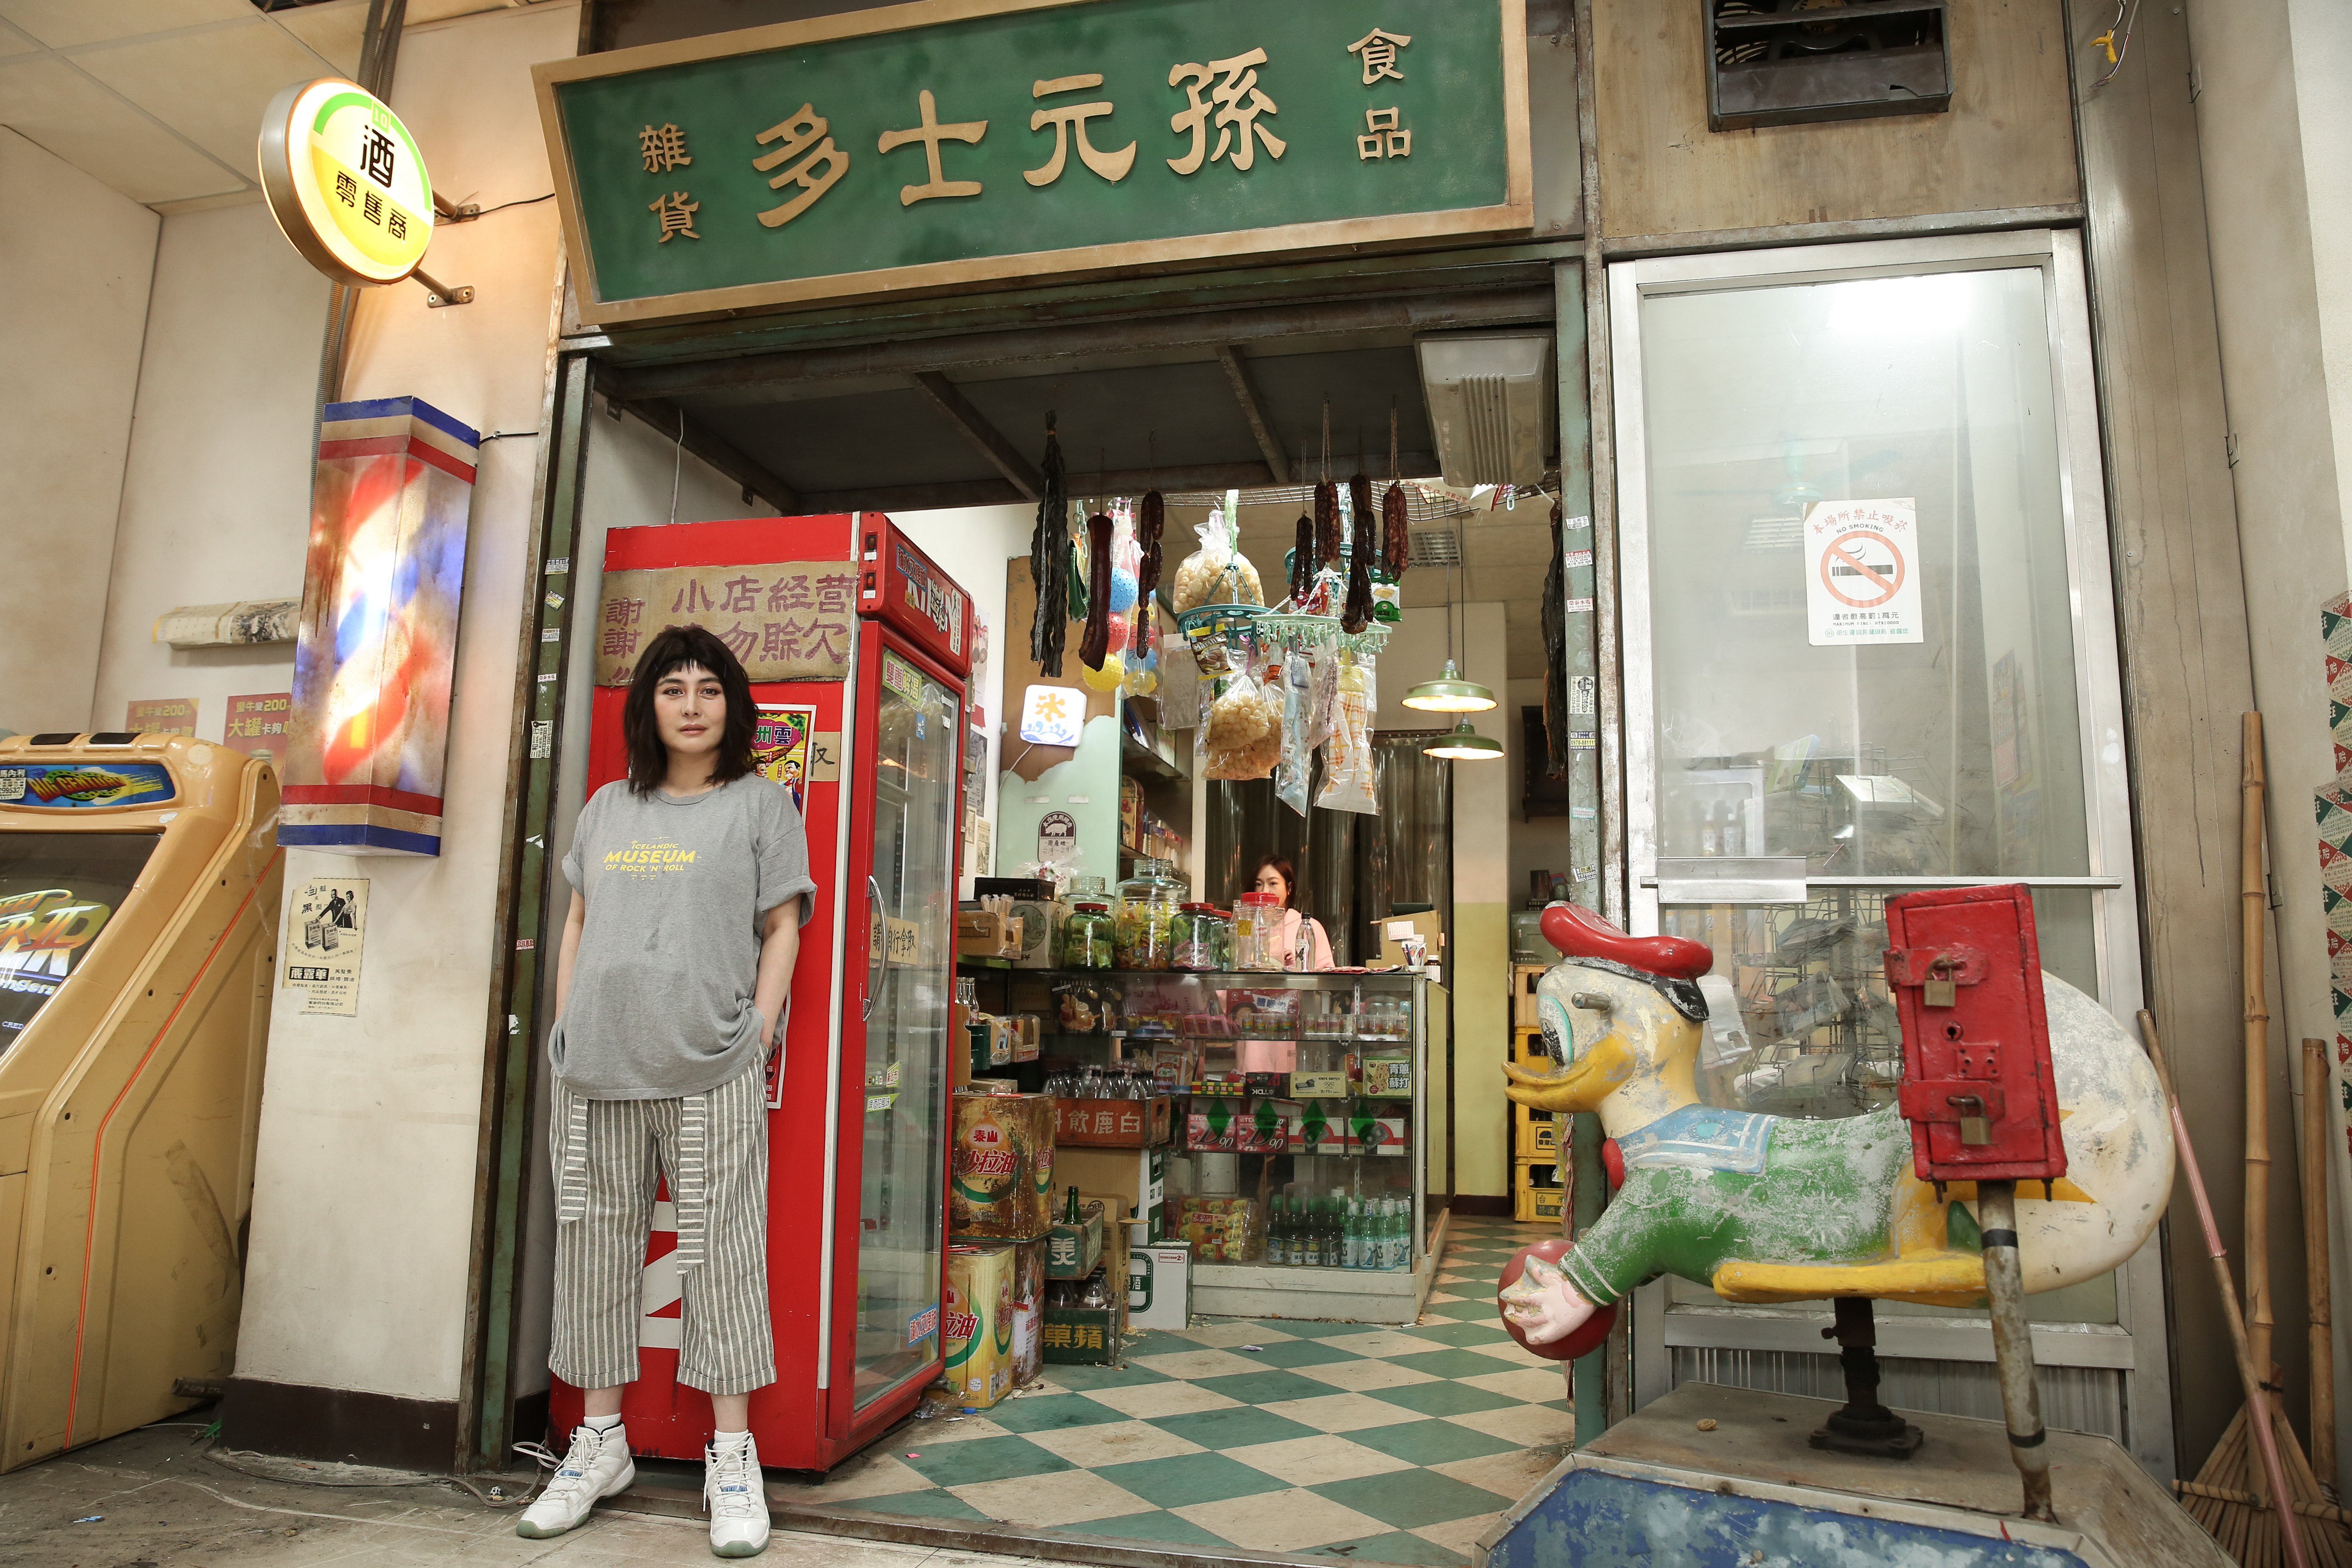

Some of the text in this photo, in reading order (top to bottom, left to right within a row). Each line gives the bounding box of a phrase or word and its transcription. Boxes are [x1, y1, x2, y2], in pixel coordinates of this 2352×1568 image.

[360, 125, 395, 188] 酒
[336, 170, 408, 241] 零售商
[1813, 508, 1908, 536] 本場所禁止吸菸
[1836, 523, 1884, 535] NO SMOKING
[657, 617, 848, 664] 勿賒欠
[886, 659, 920, 701] 雙重解渴
[27, 776, 122, 800] BIG CENTURY
[603, 850, 696, 864] MUSEUM
[0, 978, 58, 996] ngers
[2, 1021, 24, 1030] CRED
[1389, 1078, 1409, 1088] 蘇打
[973, 1130, 998, 1143] 泰山
[1217, 1137, 1234, 1148] 90
[1267, 1138, 1283, 1149] 90
[1051, 1236, 1076, 1265] 美
[1132, 1276, 1142, 1290] 酒
